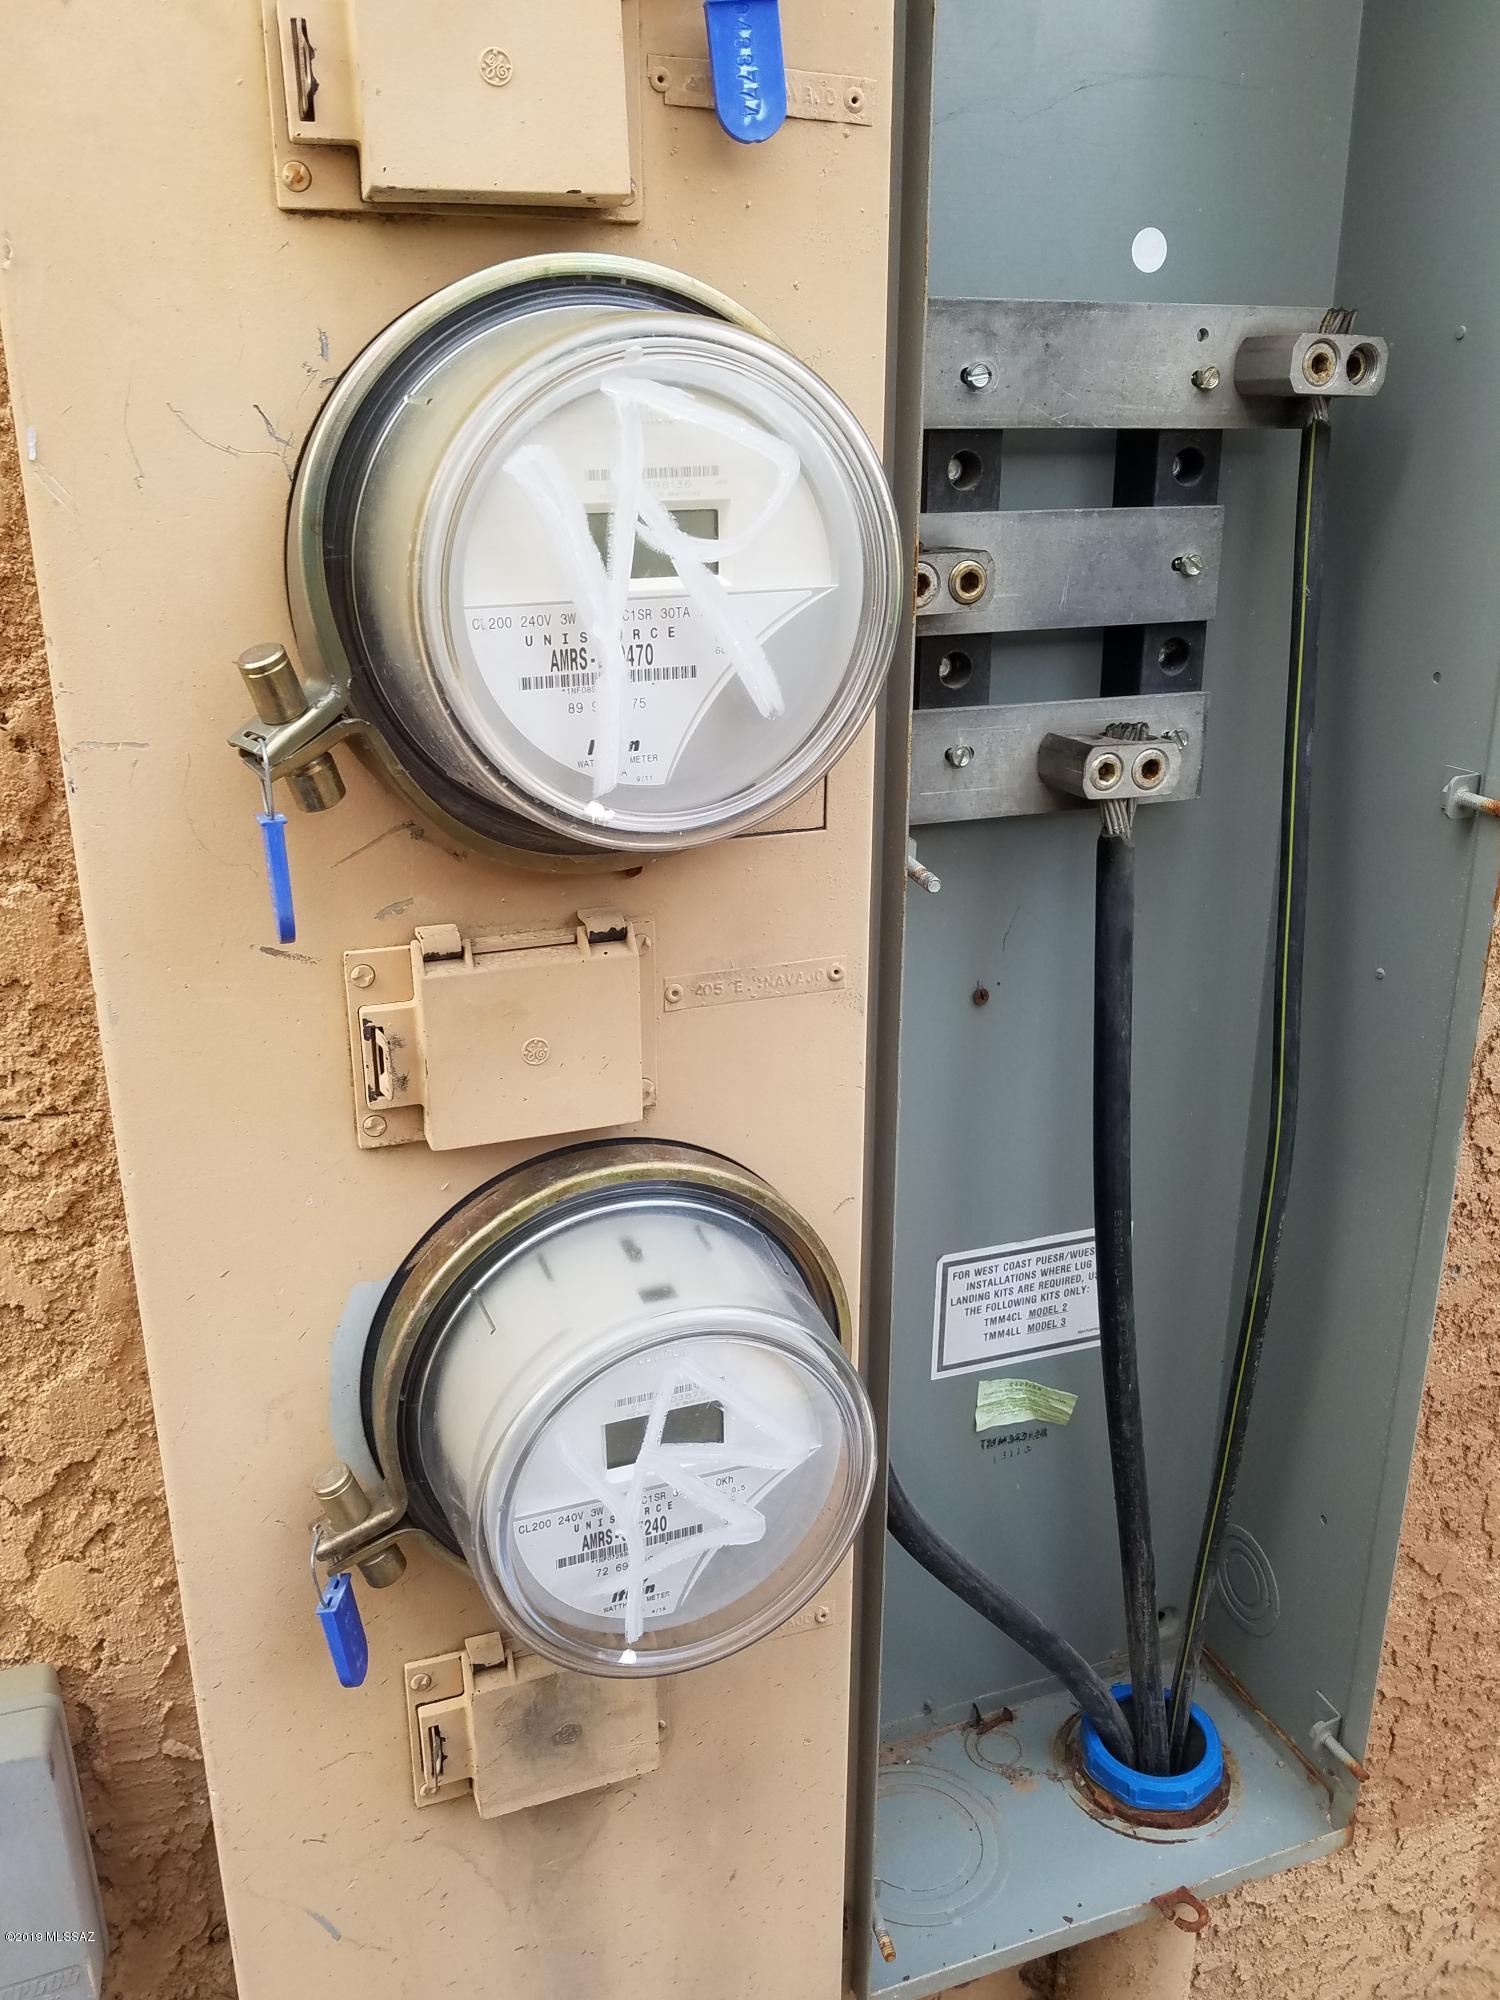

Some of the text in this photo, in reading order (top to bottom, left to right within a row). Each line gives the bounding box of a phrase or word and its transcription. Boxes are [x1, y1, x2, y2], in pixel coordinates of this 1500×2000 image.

[521, 613, 552, 628] 240V
[561, 612, 576, 625] 3W
[661, 606, 691, 619] 30TA
[629, 754, 659, 764] METER
[952, 1269, 971, 1281] FOR
[974, 1264, 1000, 1277] WEST
[1003, 1258, 1032, 1272] COAST
[966, 1259, 1092, 1291] INSTALLATIONS WHERE LUG
[950, 1290, 991, 1307] LANDING
[993, 1286, 1014, 1299] KITS
[1017, 1283, 1035, 1295] ARE
[965, 1285, 1090, 1317] THE FOLLOWING KITS ONLY:
[984, 1302, 1068, 1327] TMM4CL MODEL 2
[983, 1317, 1067, 1342] TMM4LL MODEL 3
[518, 1519, 551, 1535] CL200
[558, 1511, 584, 1526] 240V
[590, 1506, 604, 1518] 3W
[596, 1567, 609, 1578] 72
[646, 1590, 670, 1601] METER
